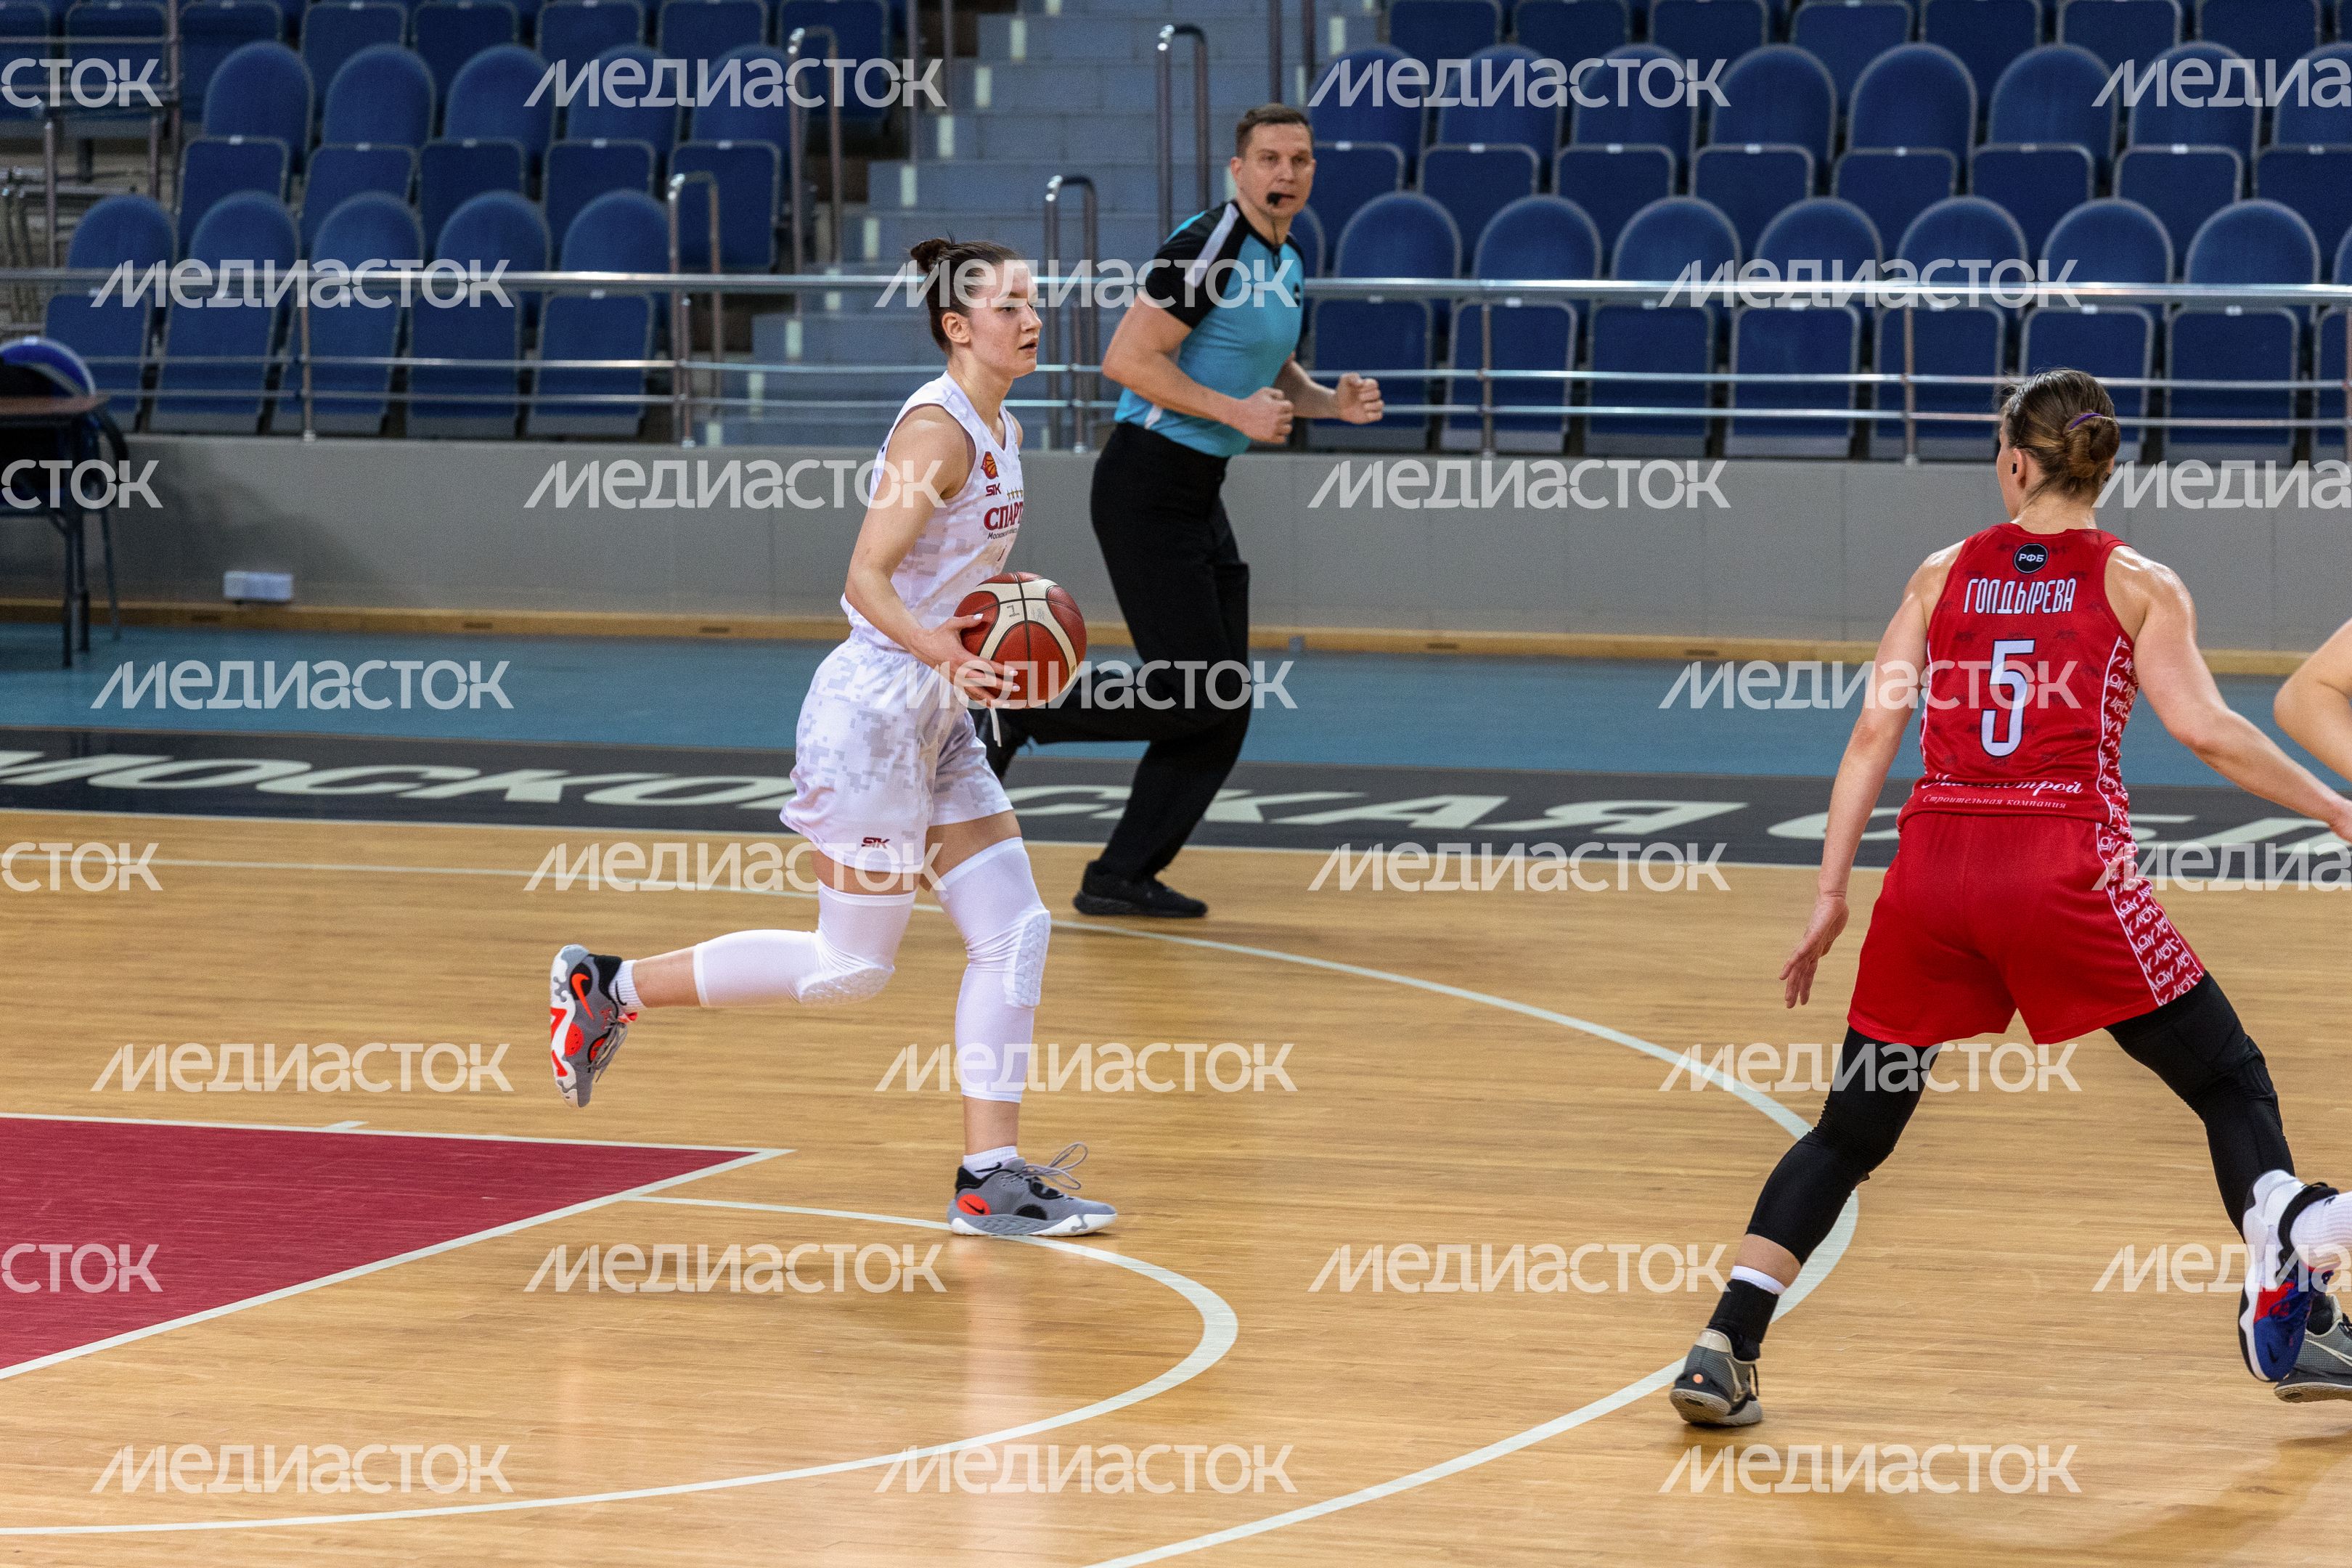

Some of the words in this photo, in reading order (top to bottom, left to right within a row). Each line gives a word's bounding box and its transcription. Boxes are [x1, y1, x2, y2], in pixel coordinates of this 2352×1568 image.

[2019, 553, 2044, 563] РФБ
[1964, 578, 2077, 615] ГОЛДЫРЕВА
[1981, 639, 2035, 757] 5
[2006, 799, 2067, 809] компания
